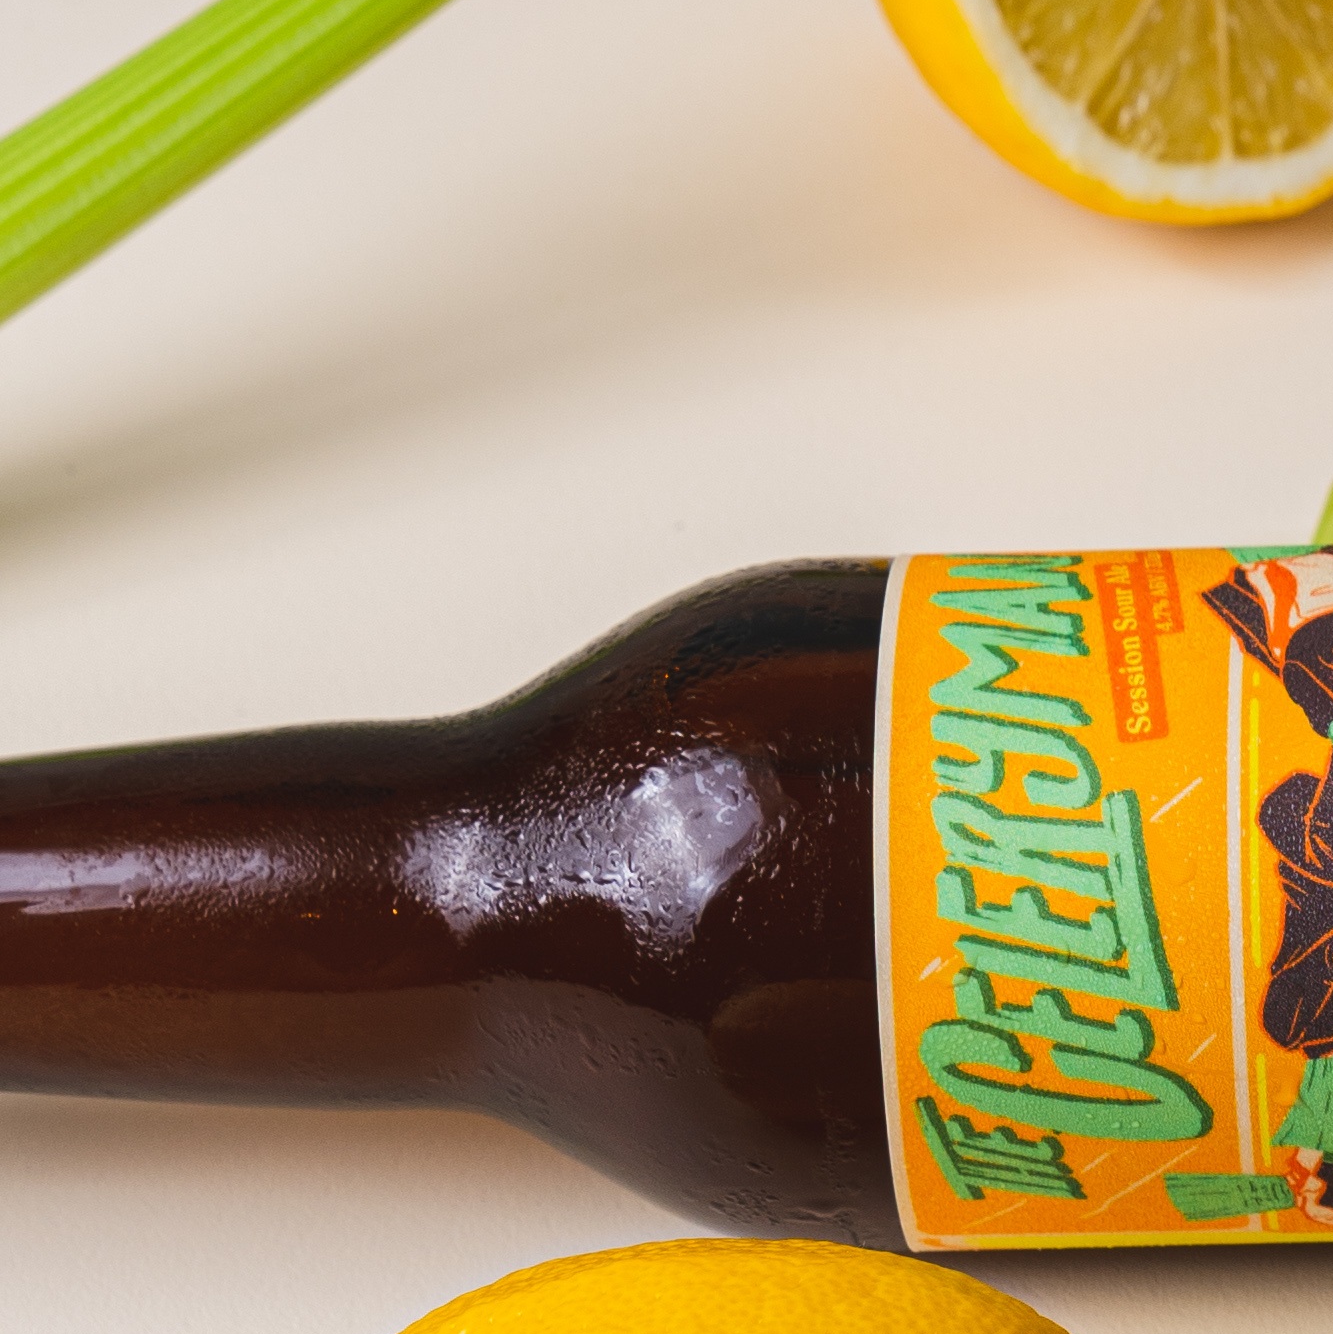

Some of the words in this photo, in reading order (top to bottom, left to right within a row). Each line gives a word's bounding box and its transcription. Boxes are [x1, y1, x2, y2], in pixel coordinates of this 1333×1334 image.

[1103, 564, 1132, 586] Ale
[1112, 587, 1138, 633] Sour
[1152, 598, 1174, 632] 4.7%
[1119, 635, 1152, 735] Session
[915, 1096, 1087, 1200] THE
